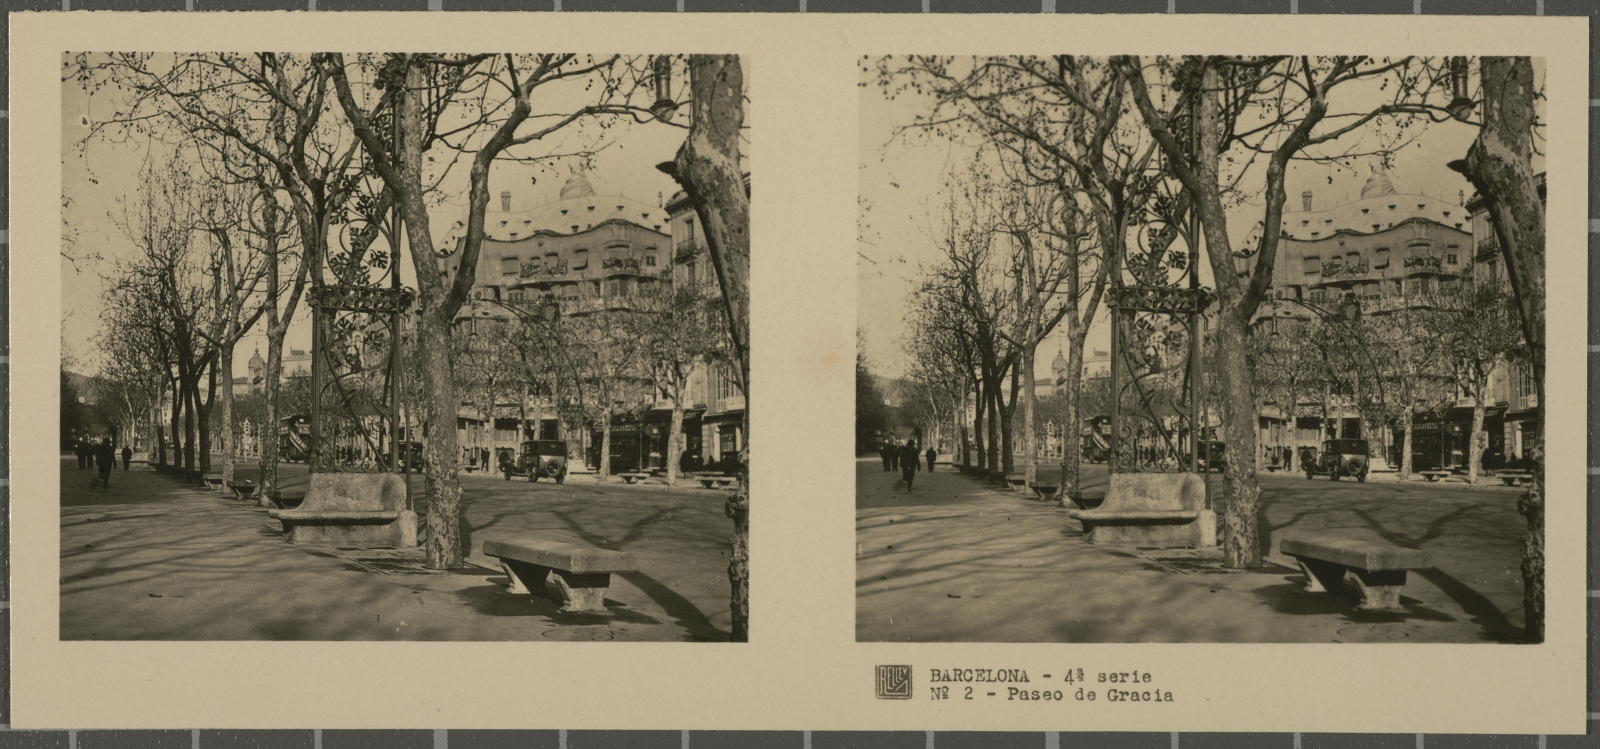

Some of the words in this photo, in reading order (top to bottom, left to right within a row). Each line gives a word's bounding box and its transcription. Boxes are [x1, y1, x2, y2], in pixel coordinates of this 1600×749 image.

[930, 668, 1031, 683] BARCELONA
[1097, 669, 1152, 684] serie
[929, 685, 950, 701] Nº
[964, 686, 974, 701] 2
[1007, 686, 1064, 702] Paseo
[1074, 686, 1097, 702] de
[1107, 687, 1175, 703] Gracia
